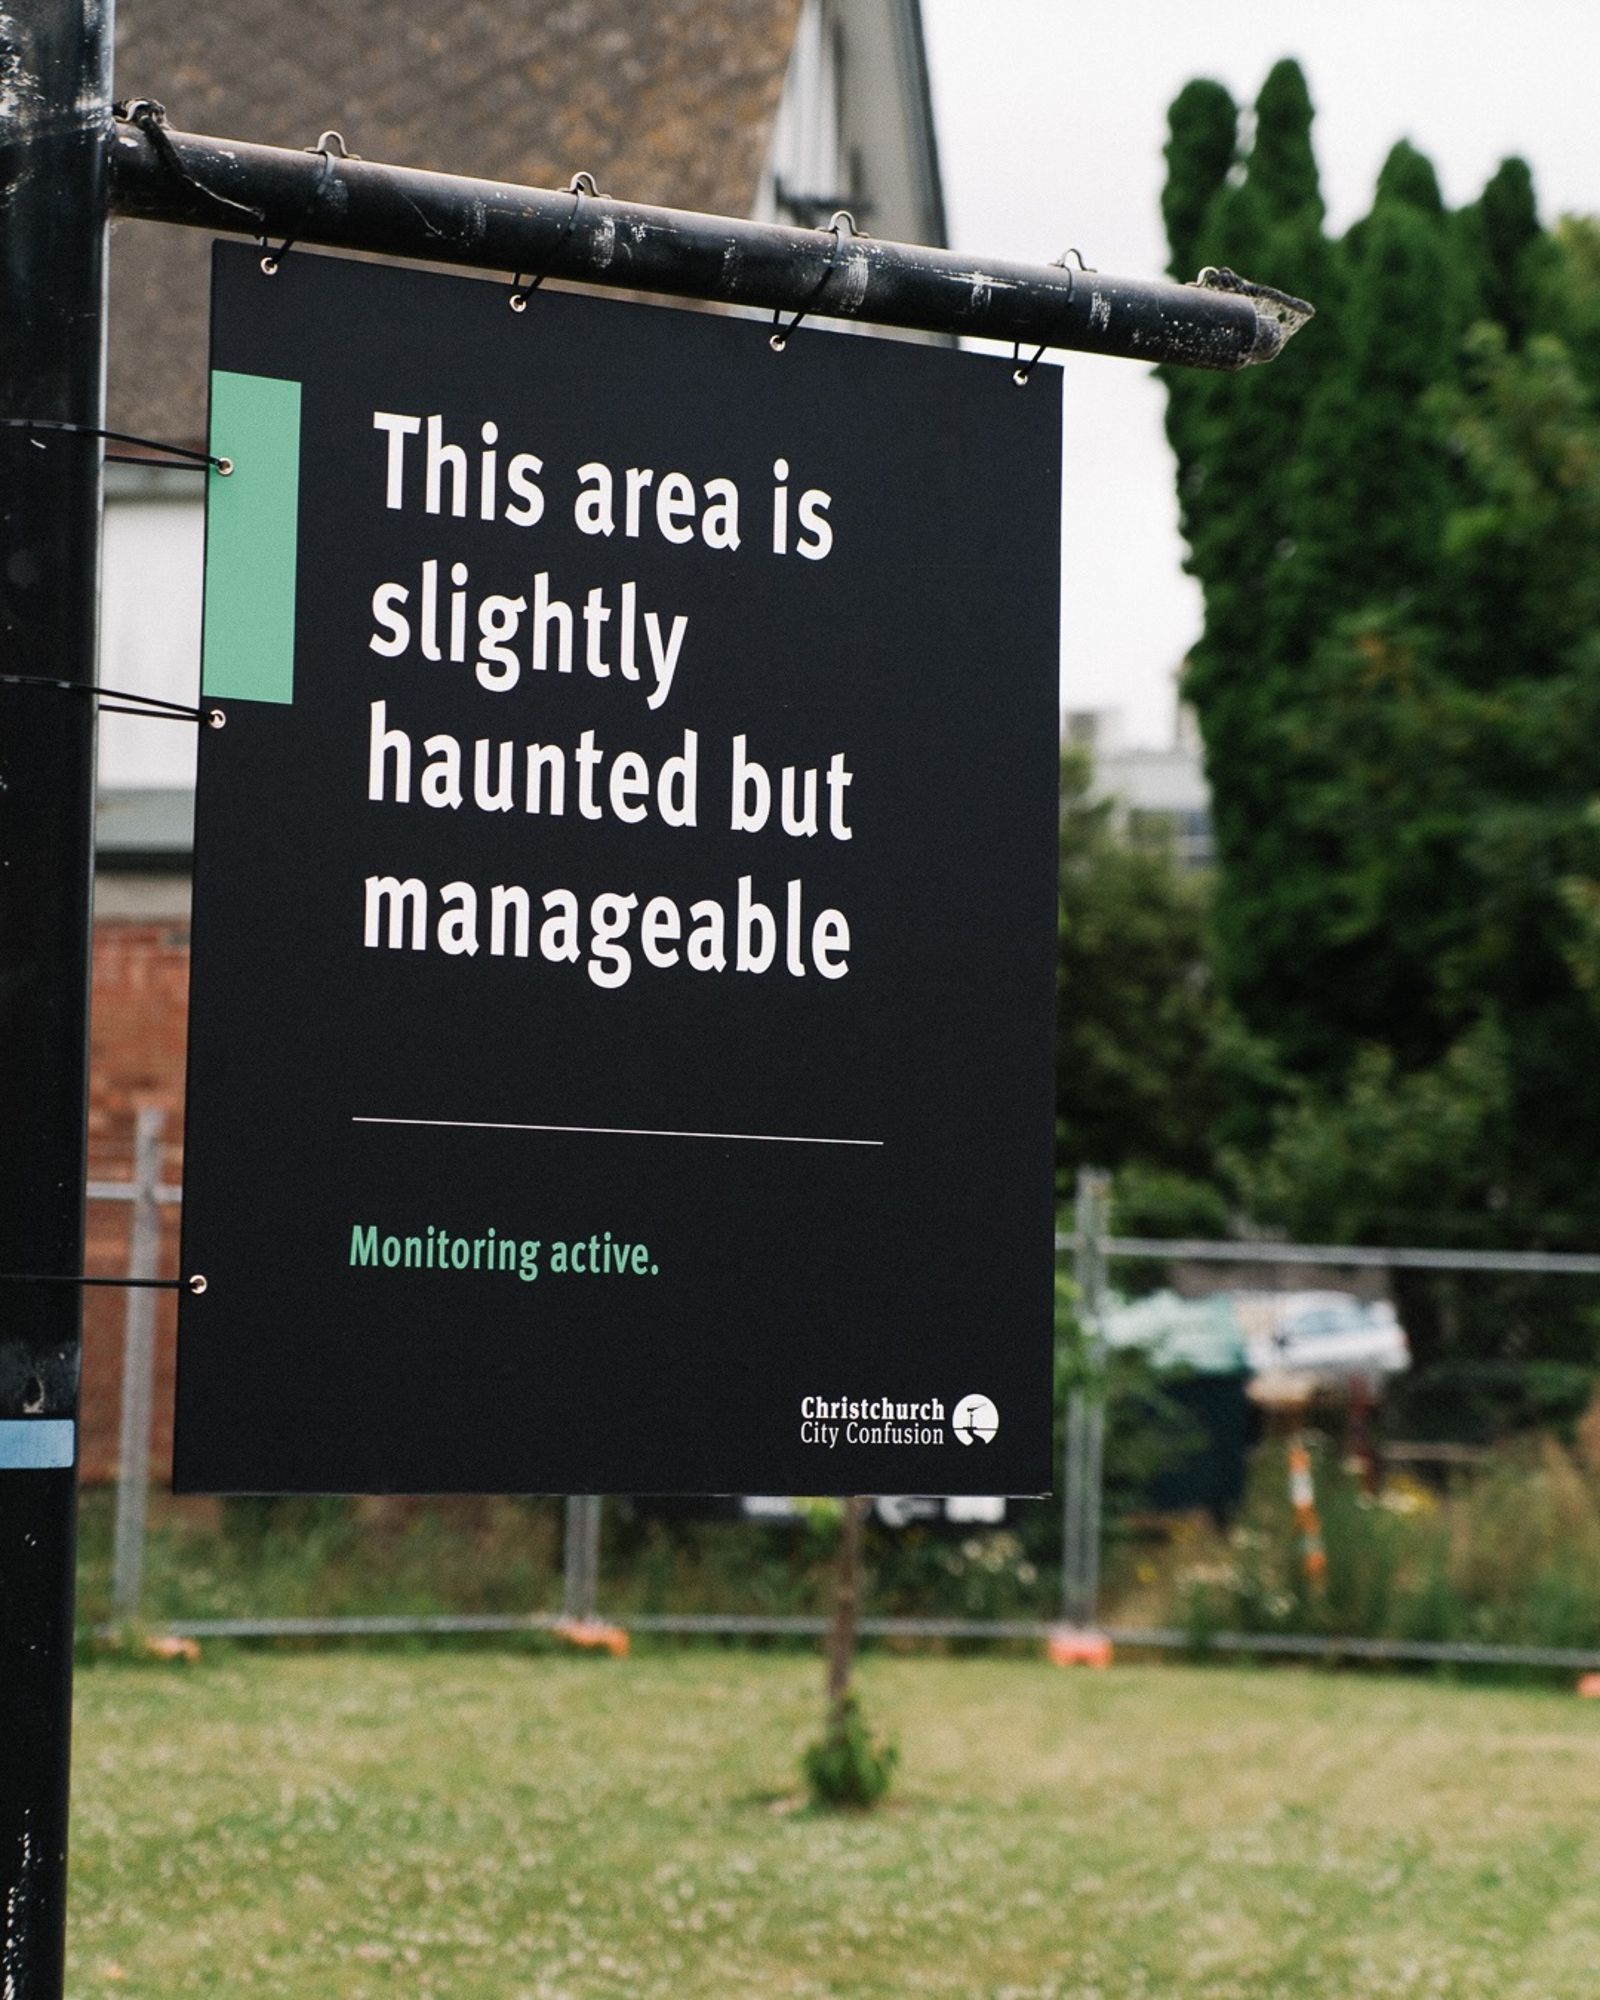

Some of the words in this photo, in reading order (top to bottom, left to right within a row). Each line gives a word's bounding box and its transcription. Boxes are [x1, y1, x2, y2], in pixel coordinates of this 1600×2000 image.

[372, 410, 544, 529] This
[574, 461, 742, 552] area
[772, 457, 834, 562] is
[368, 559, 688, 711] slightly
[368, 699, 698, 829] haunted
[729, 733, 854, 841] but
[363, 873, 852, 991] manageable
[349, 1224, 541, 1282] Monitoring
[550, 1231, 659, 1276] active.
[800, 1396, 945, 1421] Christchurch
[800, 1420, 840, 1449] City
[846, 1422, 945, 1445] Confusion
